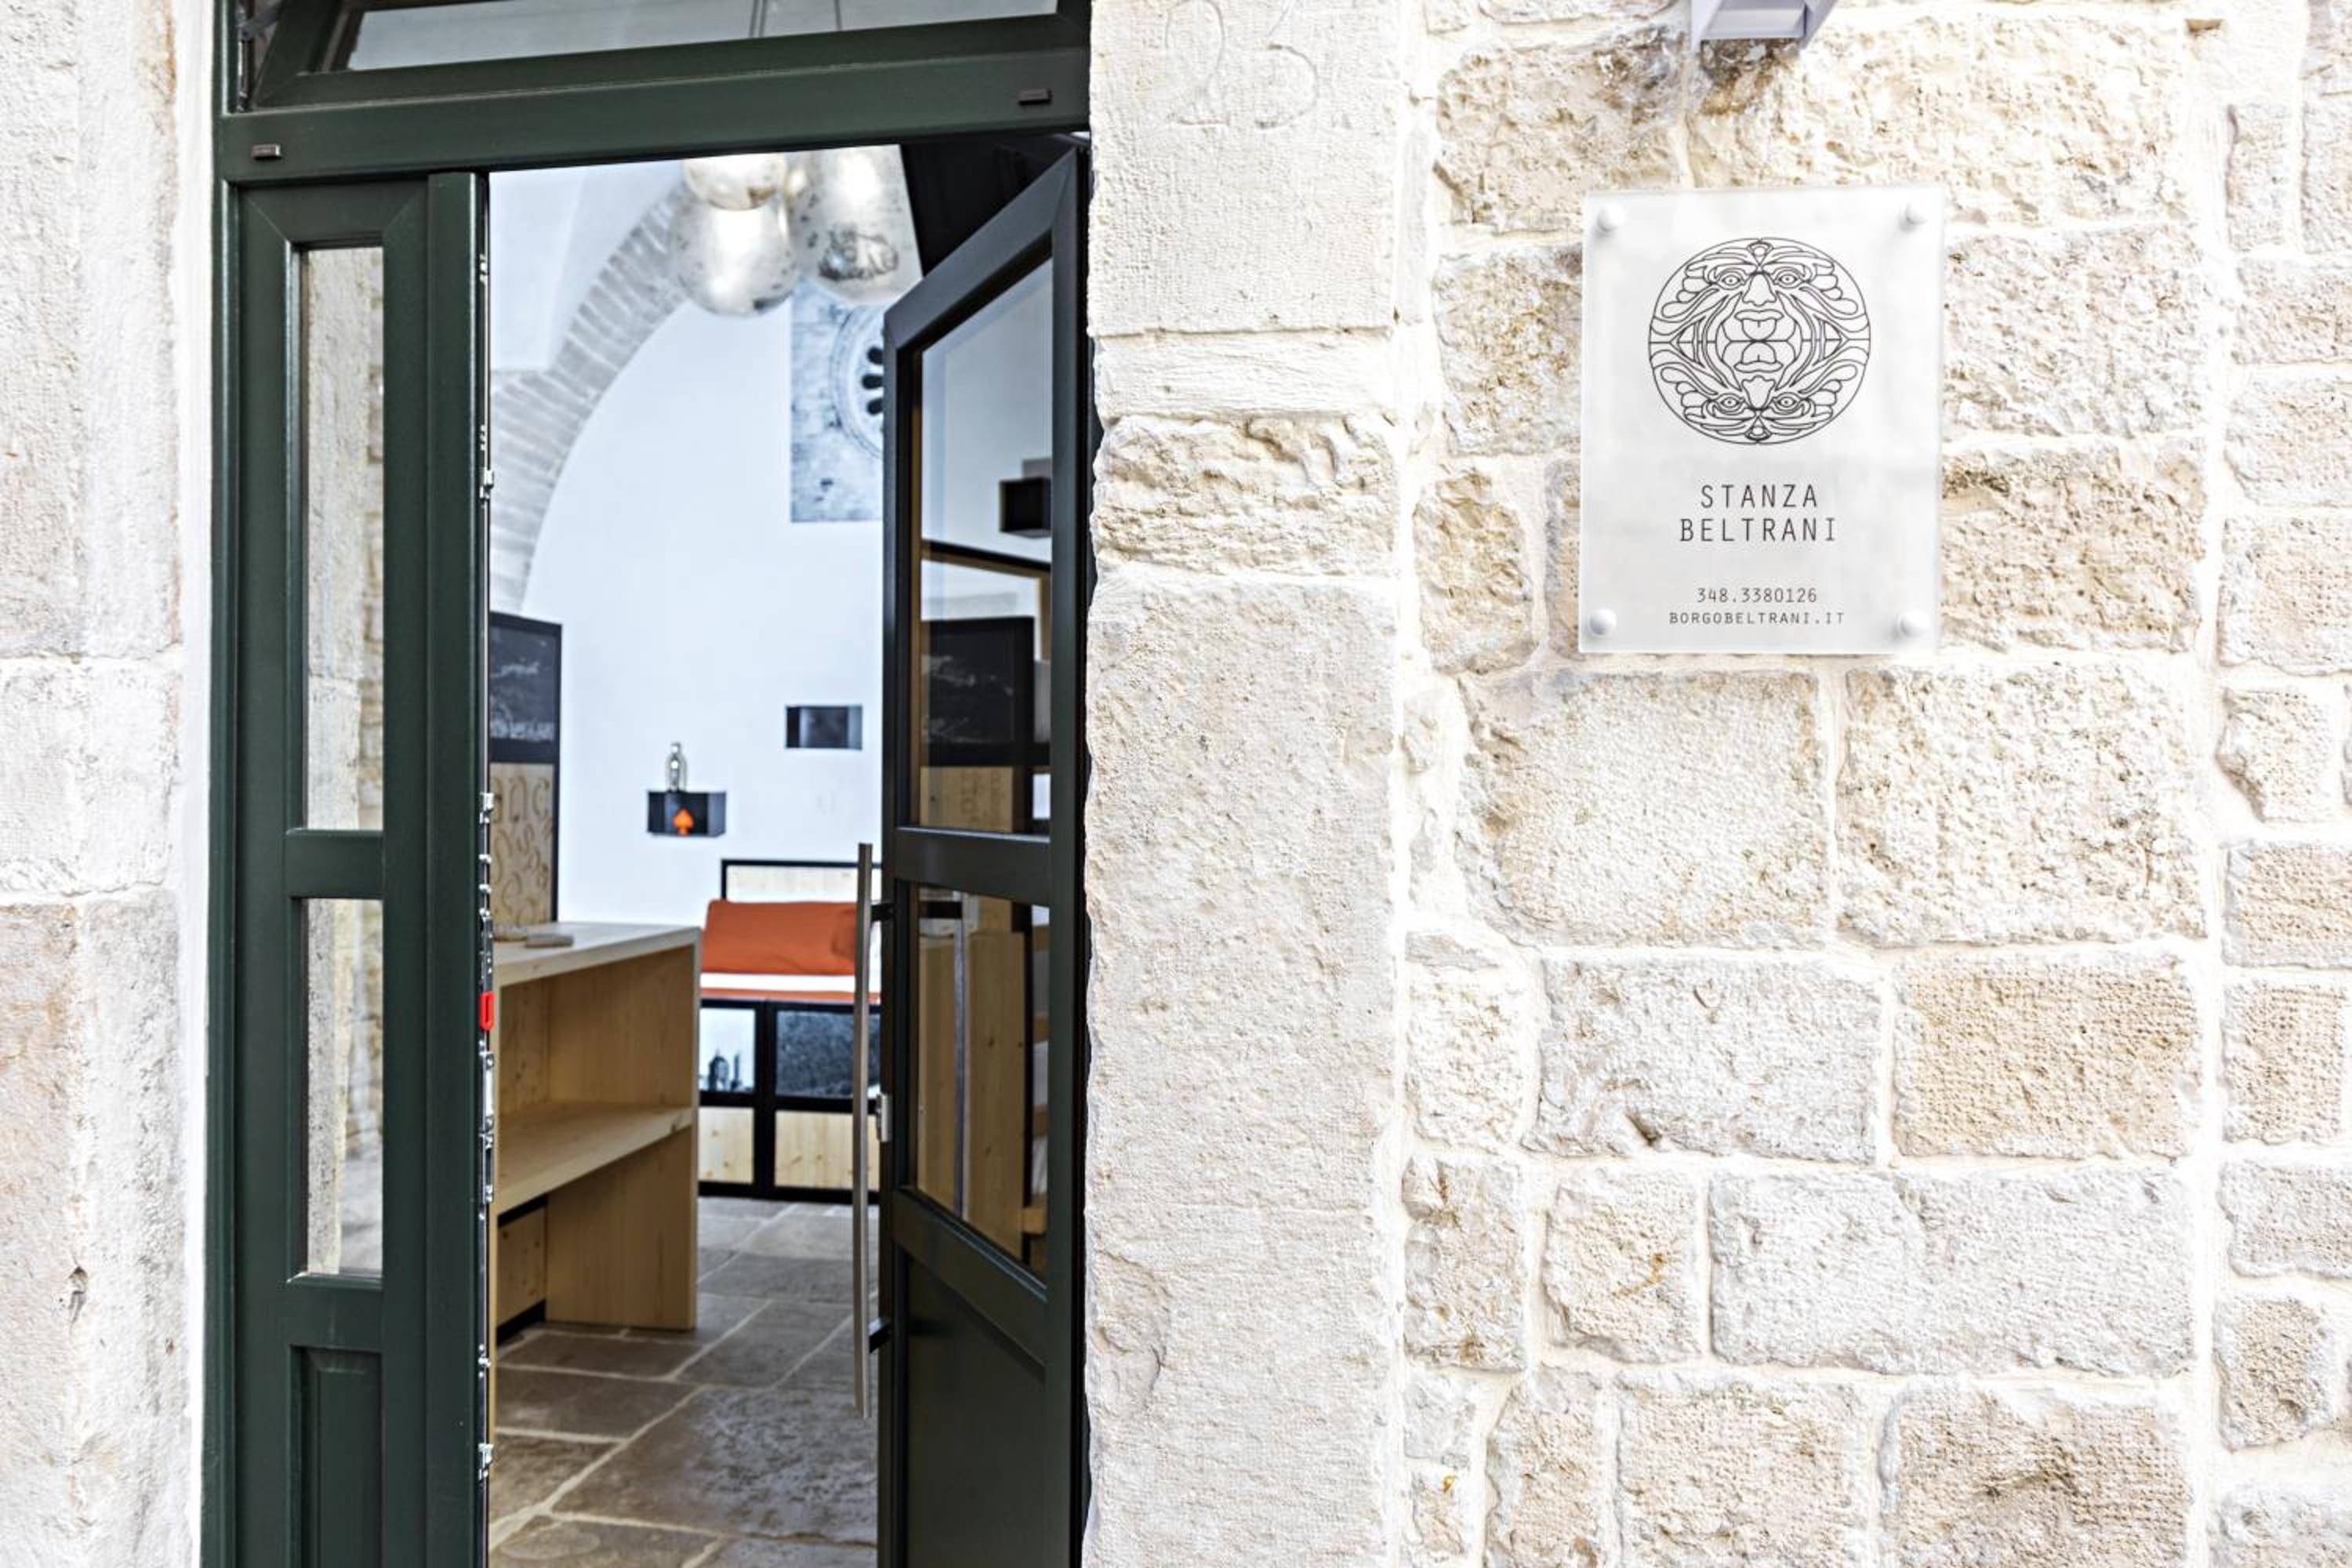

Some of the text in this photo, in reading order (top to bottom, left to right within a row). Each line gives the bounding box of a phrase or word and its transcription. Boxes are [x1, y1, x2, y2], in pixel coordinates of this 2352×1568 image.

[1700, 484, 1818, 509] STANZA
[1679, 517, 1836, 542] BELTRANI
[1697, 587, 1817, 603] 348.3380126
[1669, 612, 1844, 625] BORGOBELTRANI.IT
